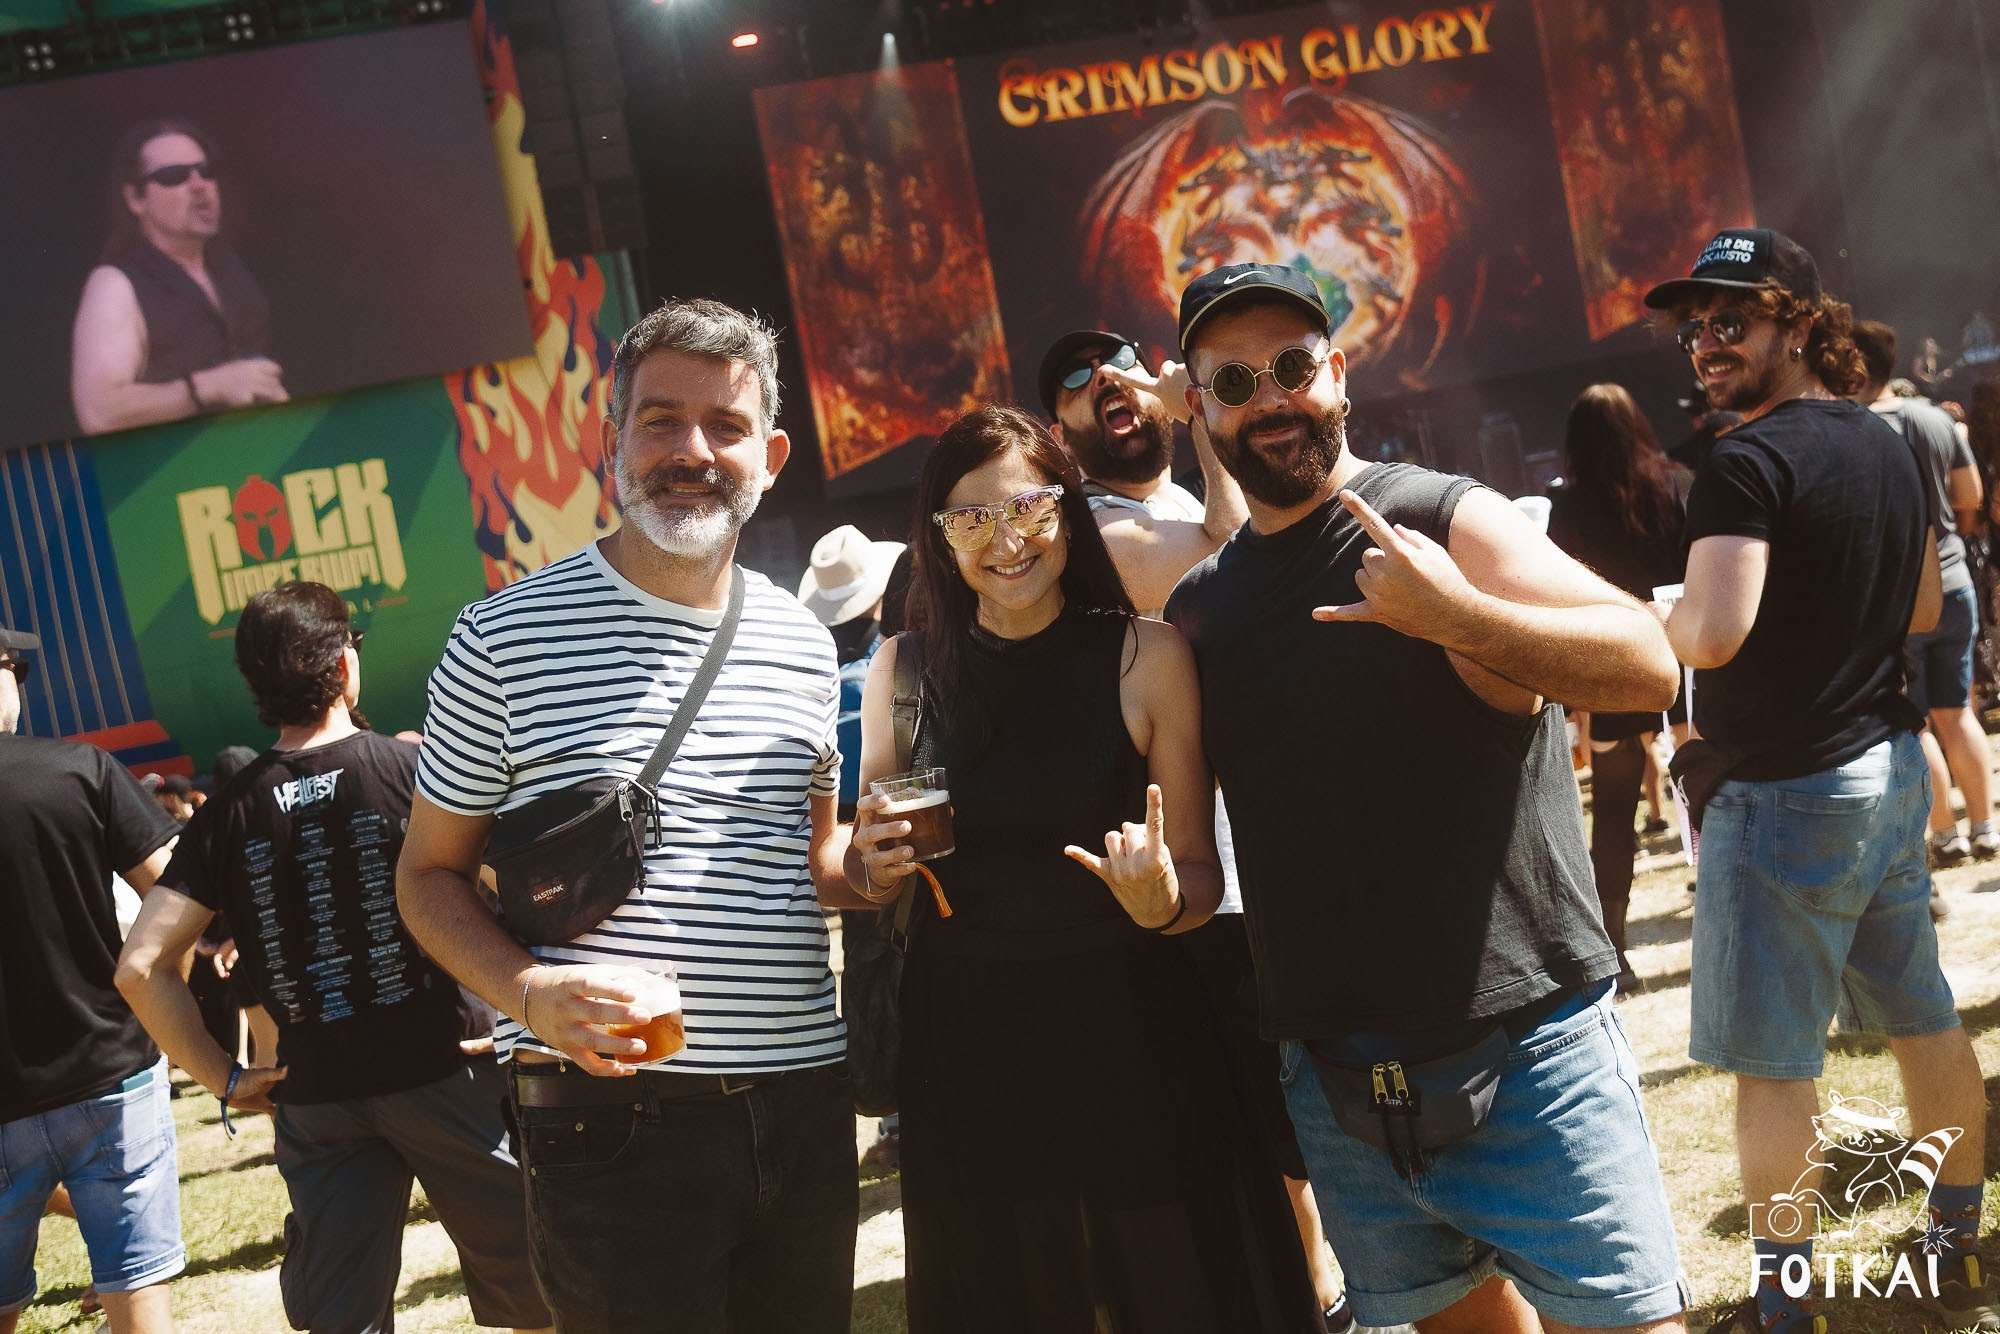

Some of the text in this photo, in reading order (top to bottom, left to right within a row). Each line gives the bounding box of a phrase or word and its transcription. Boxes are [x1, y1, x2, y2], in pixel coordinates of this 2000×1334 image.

[999, 2, 1496, 128] CRIMSON GLORY
[1733, 238, 1755, 253] DEL
[273, 767, 344, 813] HELLFEST
[532, 884, 564, 902] EASTPAK
